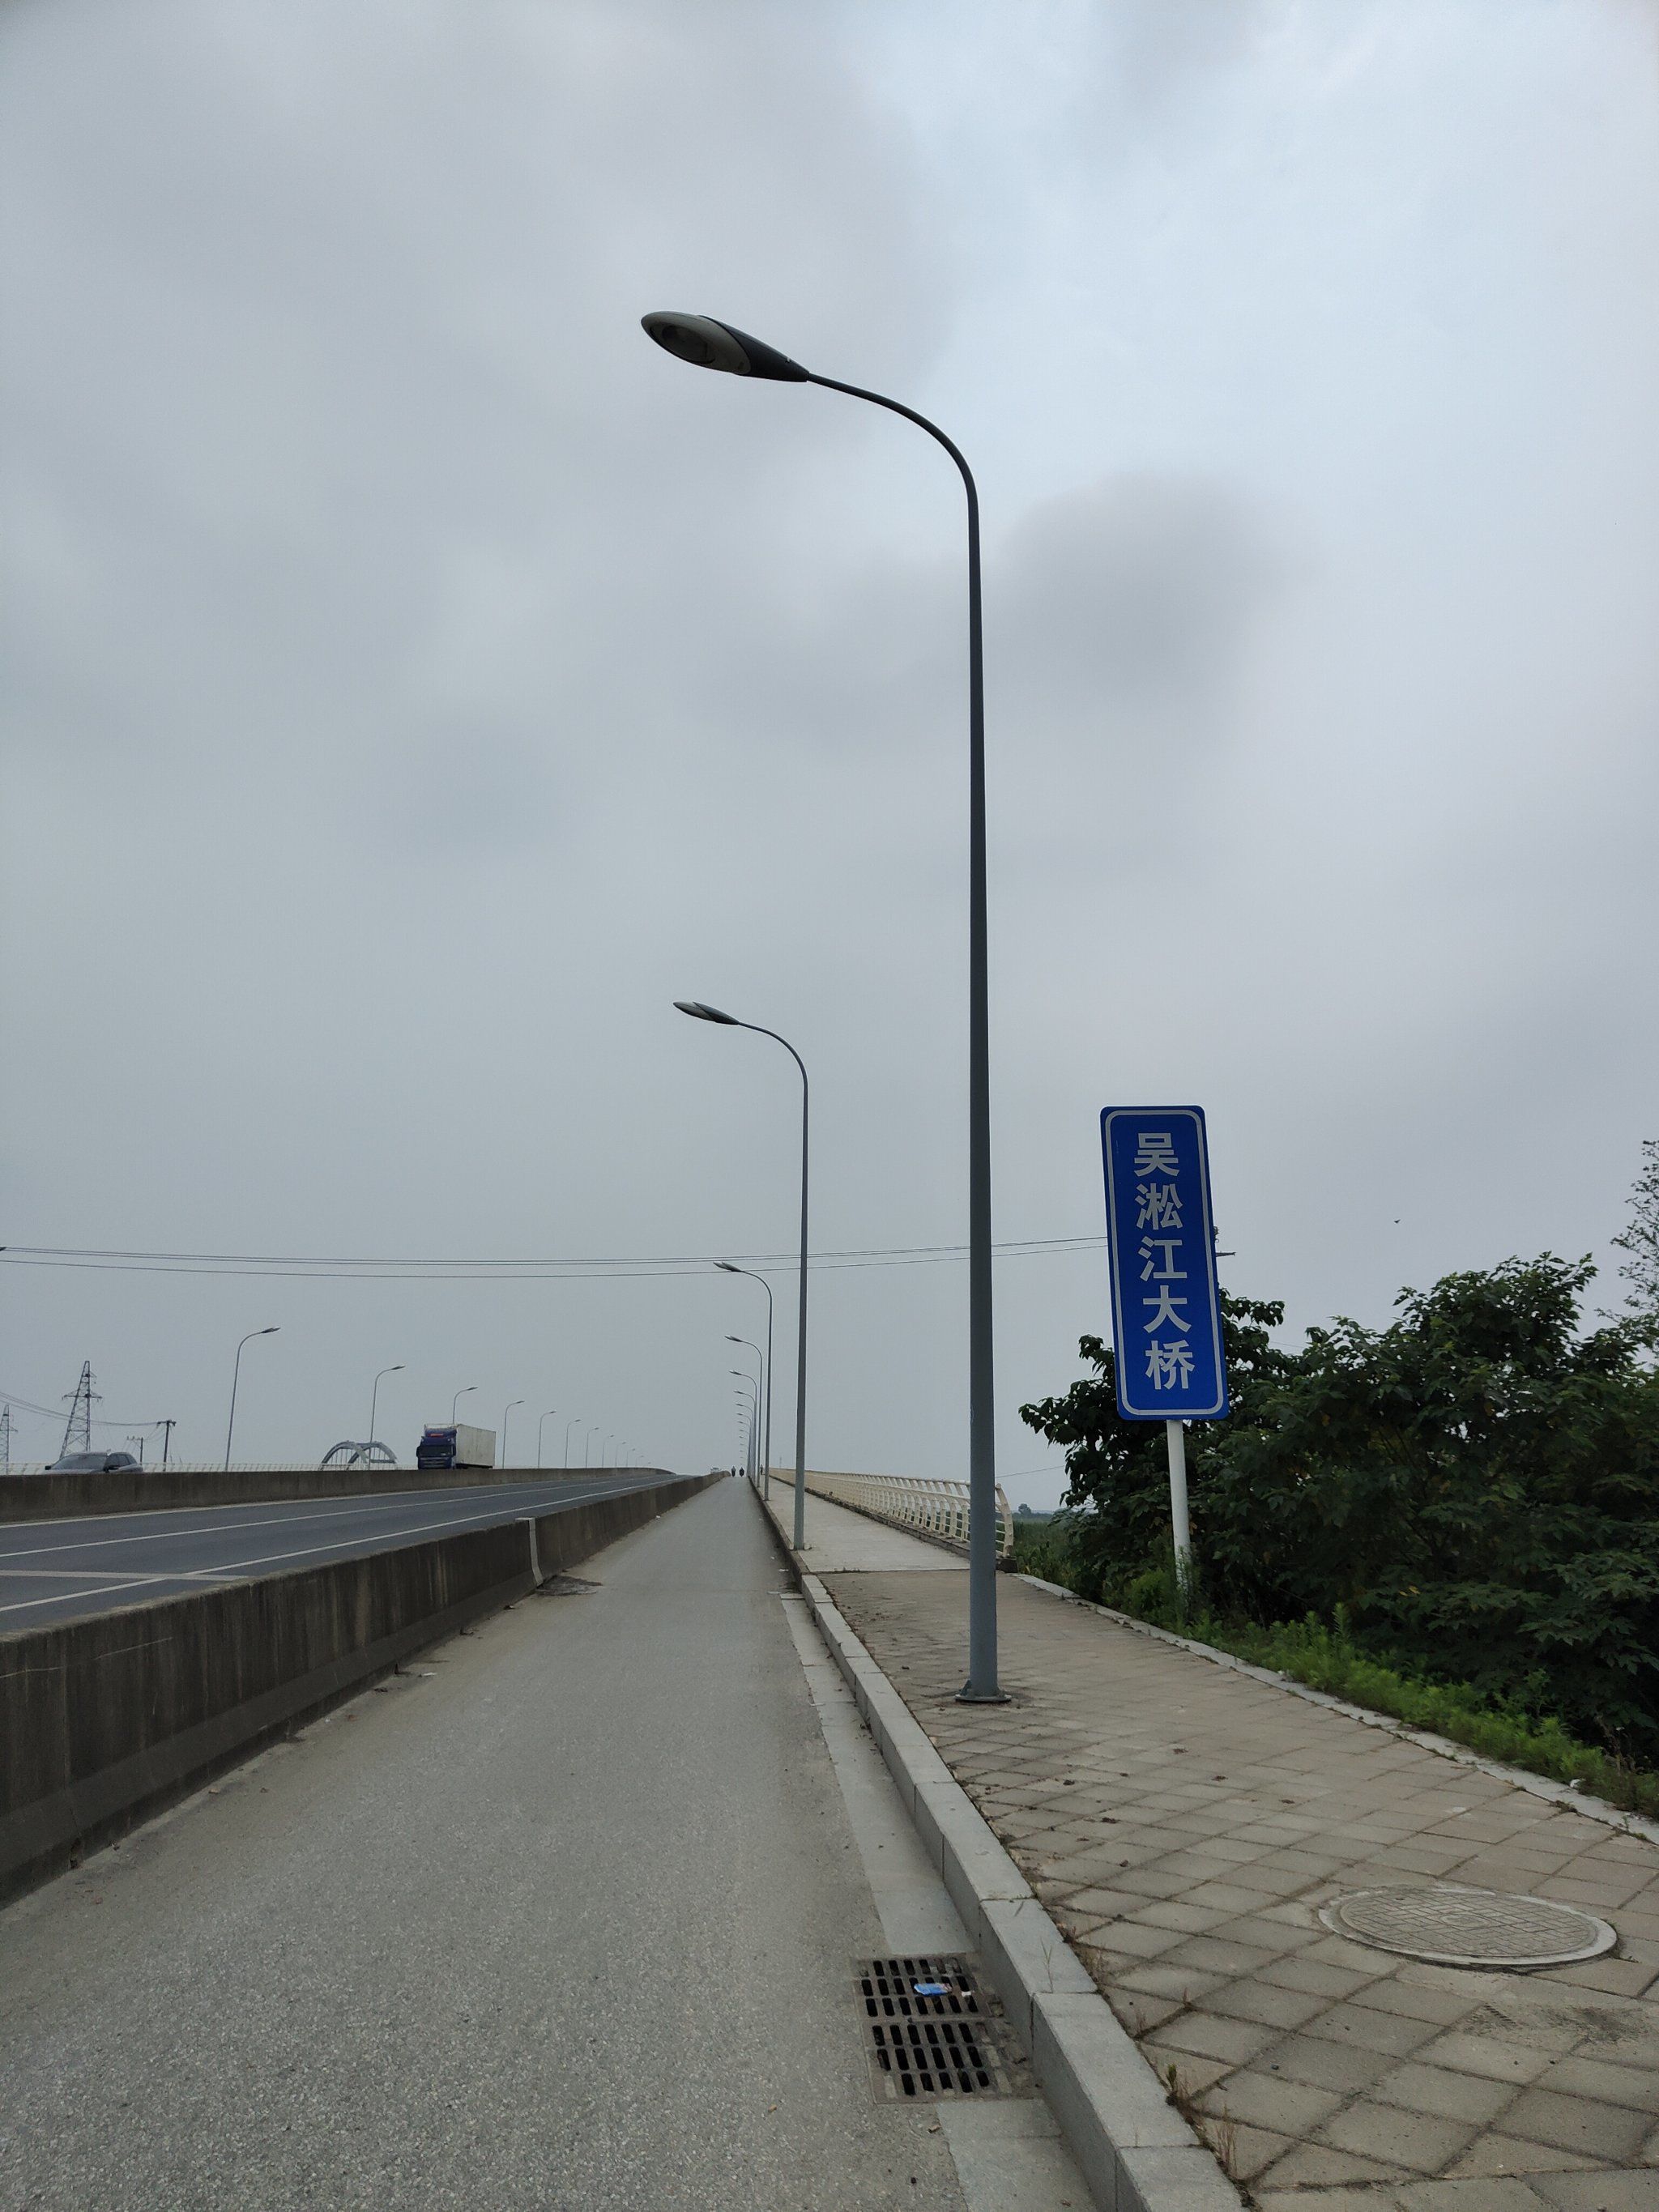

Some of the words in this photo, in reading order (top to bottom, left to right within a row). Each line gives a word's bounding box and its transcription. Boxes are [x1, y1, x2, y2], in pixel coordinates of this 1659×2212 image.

[1134, 1132, 1195, 1390] 吴淞江大桥
